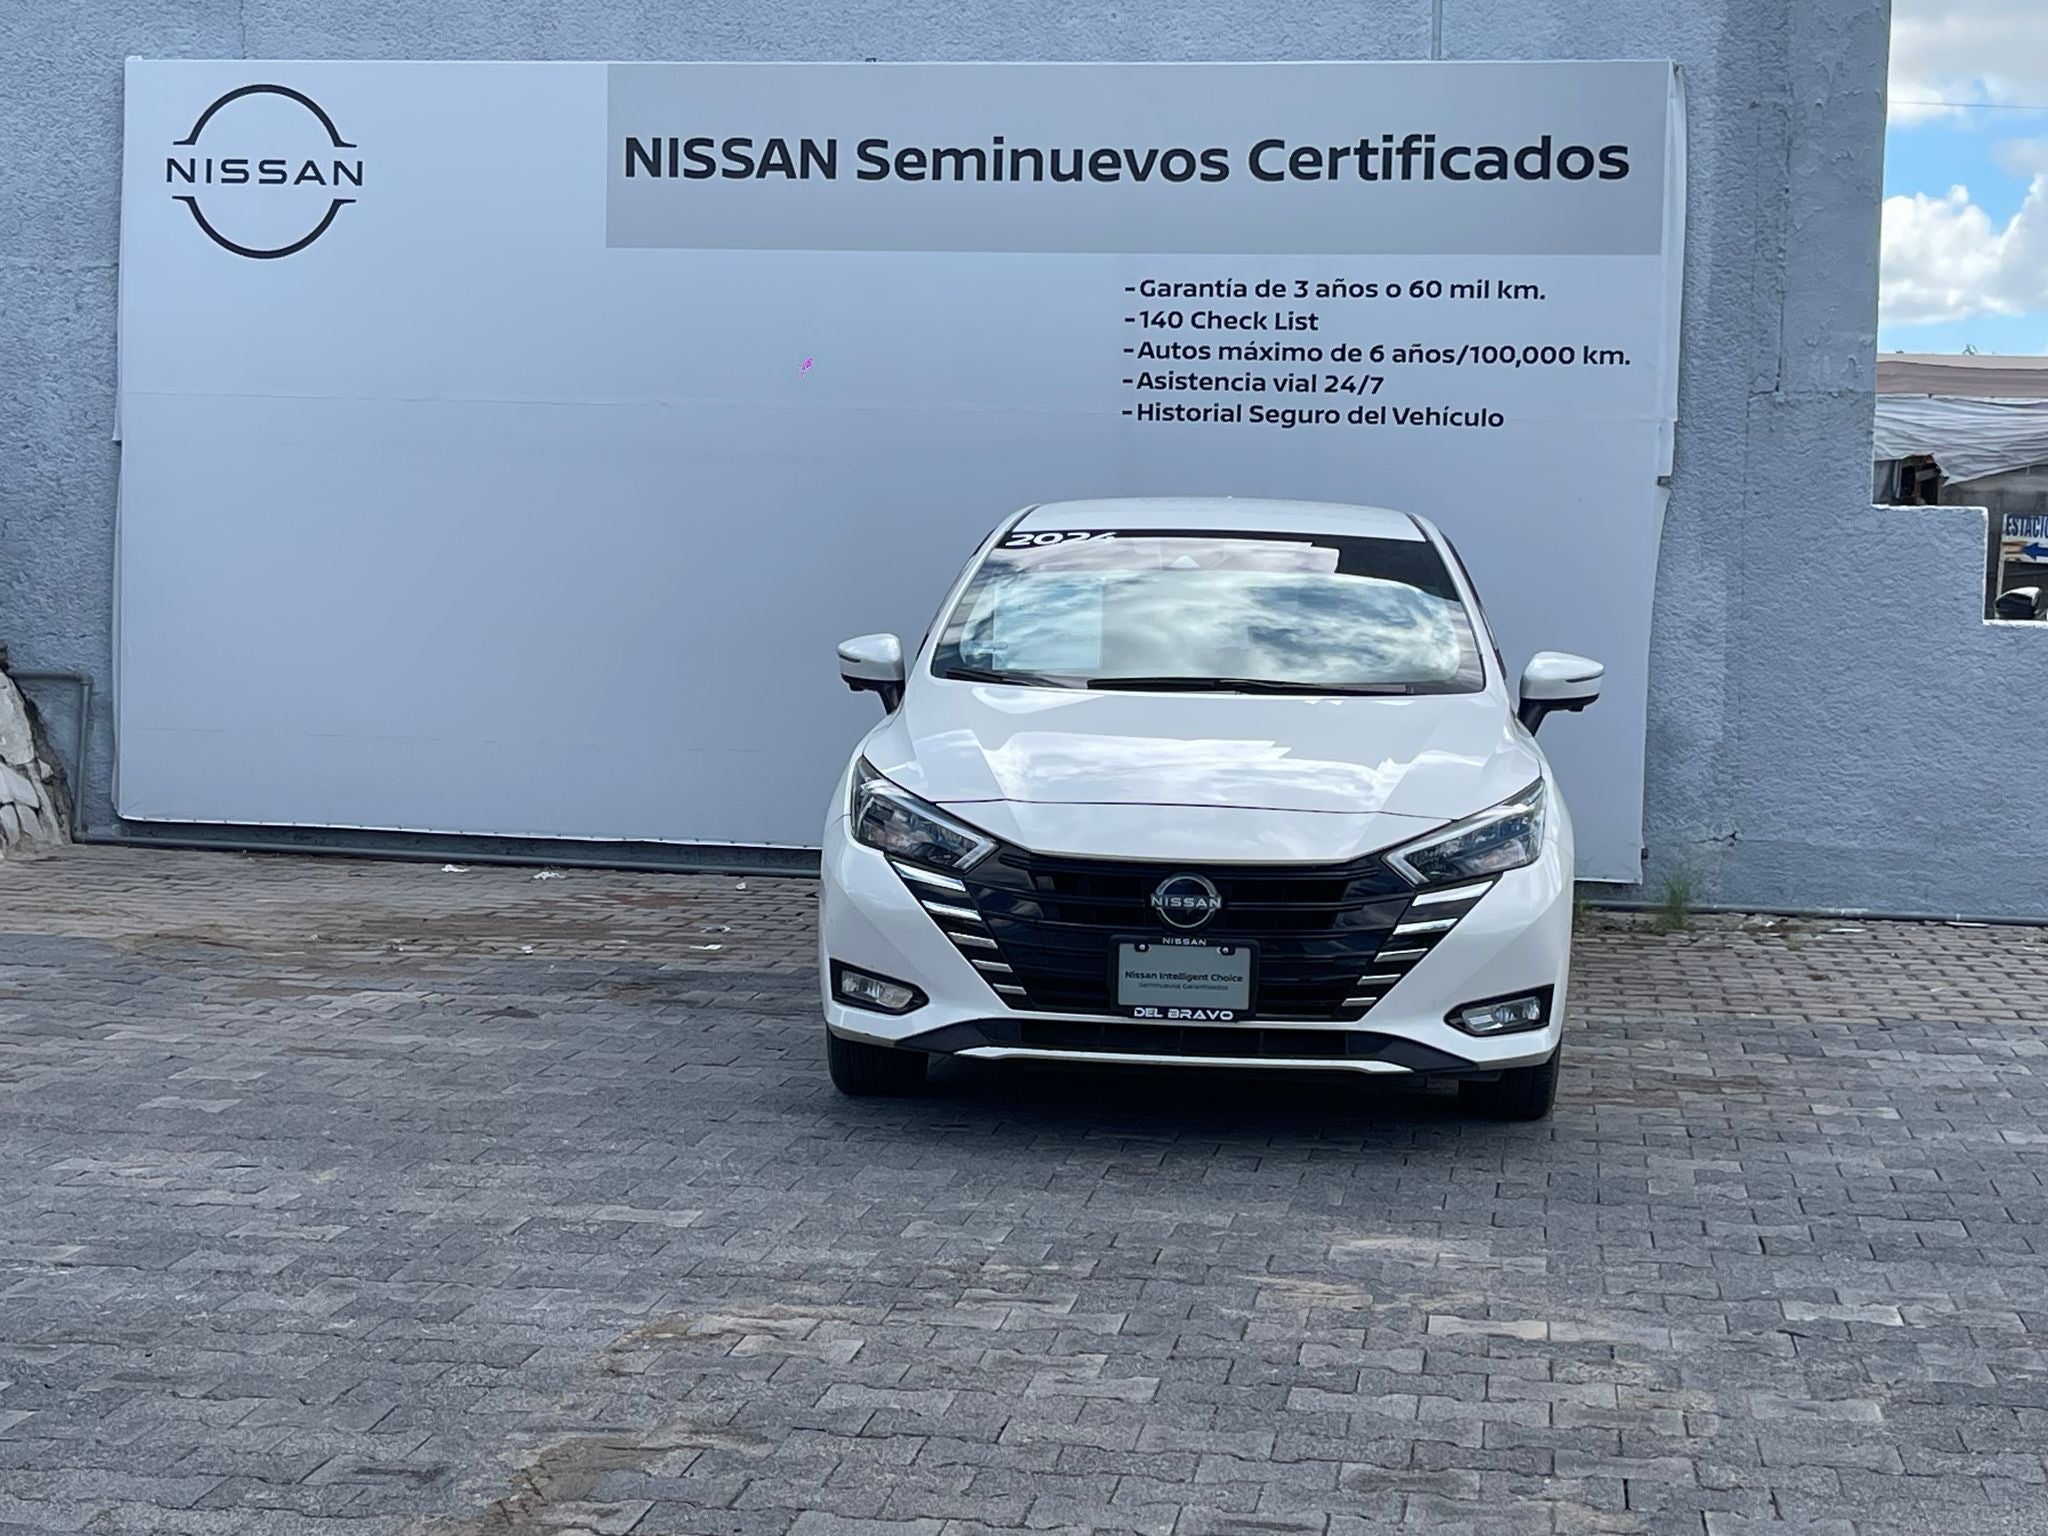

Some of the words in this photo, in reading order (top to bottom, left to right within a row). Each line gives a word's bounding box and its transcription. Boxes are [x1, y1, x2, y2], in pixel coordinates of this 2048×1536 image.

[625, 136, 837, 180] NISSAN
[856, 135, 1230, 183] Seminuevos
[1248, 133, 1630, 182] Certificados
[166, 157, 364, 187] NISSAN
[1254, 278, 1287, 299] de
[1293, 279, 1309, 299] 3
[1315, 277, 1379, 299] años
[1385, 283, 1402, 299] o
[1408, 279, 1443, 299] 60
[1449, 278, 1490, 300] mil
[1497, 279, 1546, 300] km.
[1190, 310, 1268, 331] Check
[1274, 310, 1320, 332] List
[1218, 340, 1323, 363] máximo
[1330, 342, 1363, 363] de
[1369, 344, 1385, 363] 6
[1391, 343, 1576, 369] años/100,000
[1583, 345, 1631, 366] km.
[1272, 373, 1317, 393] vial
[1323, 374, 1385, 396] 24/7
[1248, 404, 1341, 429] Seguro
[1347, 405, 1386, 426] del
[1391, 406, 1505, 428] Vehículo
[1150, 895, 1222, 909] NISSAN
[1162, 936, 1207, 946] NISSAN
[1124, 970, 1158, 980] Nissan
[1159, 972, 1209, 983] Intelligent
[1210, 973, 1243, 983] Choice
[1133, 1007, 1164, 1019] DEL
[1167, 1008, 1234, 1021] BRAVO
